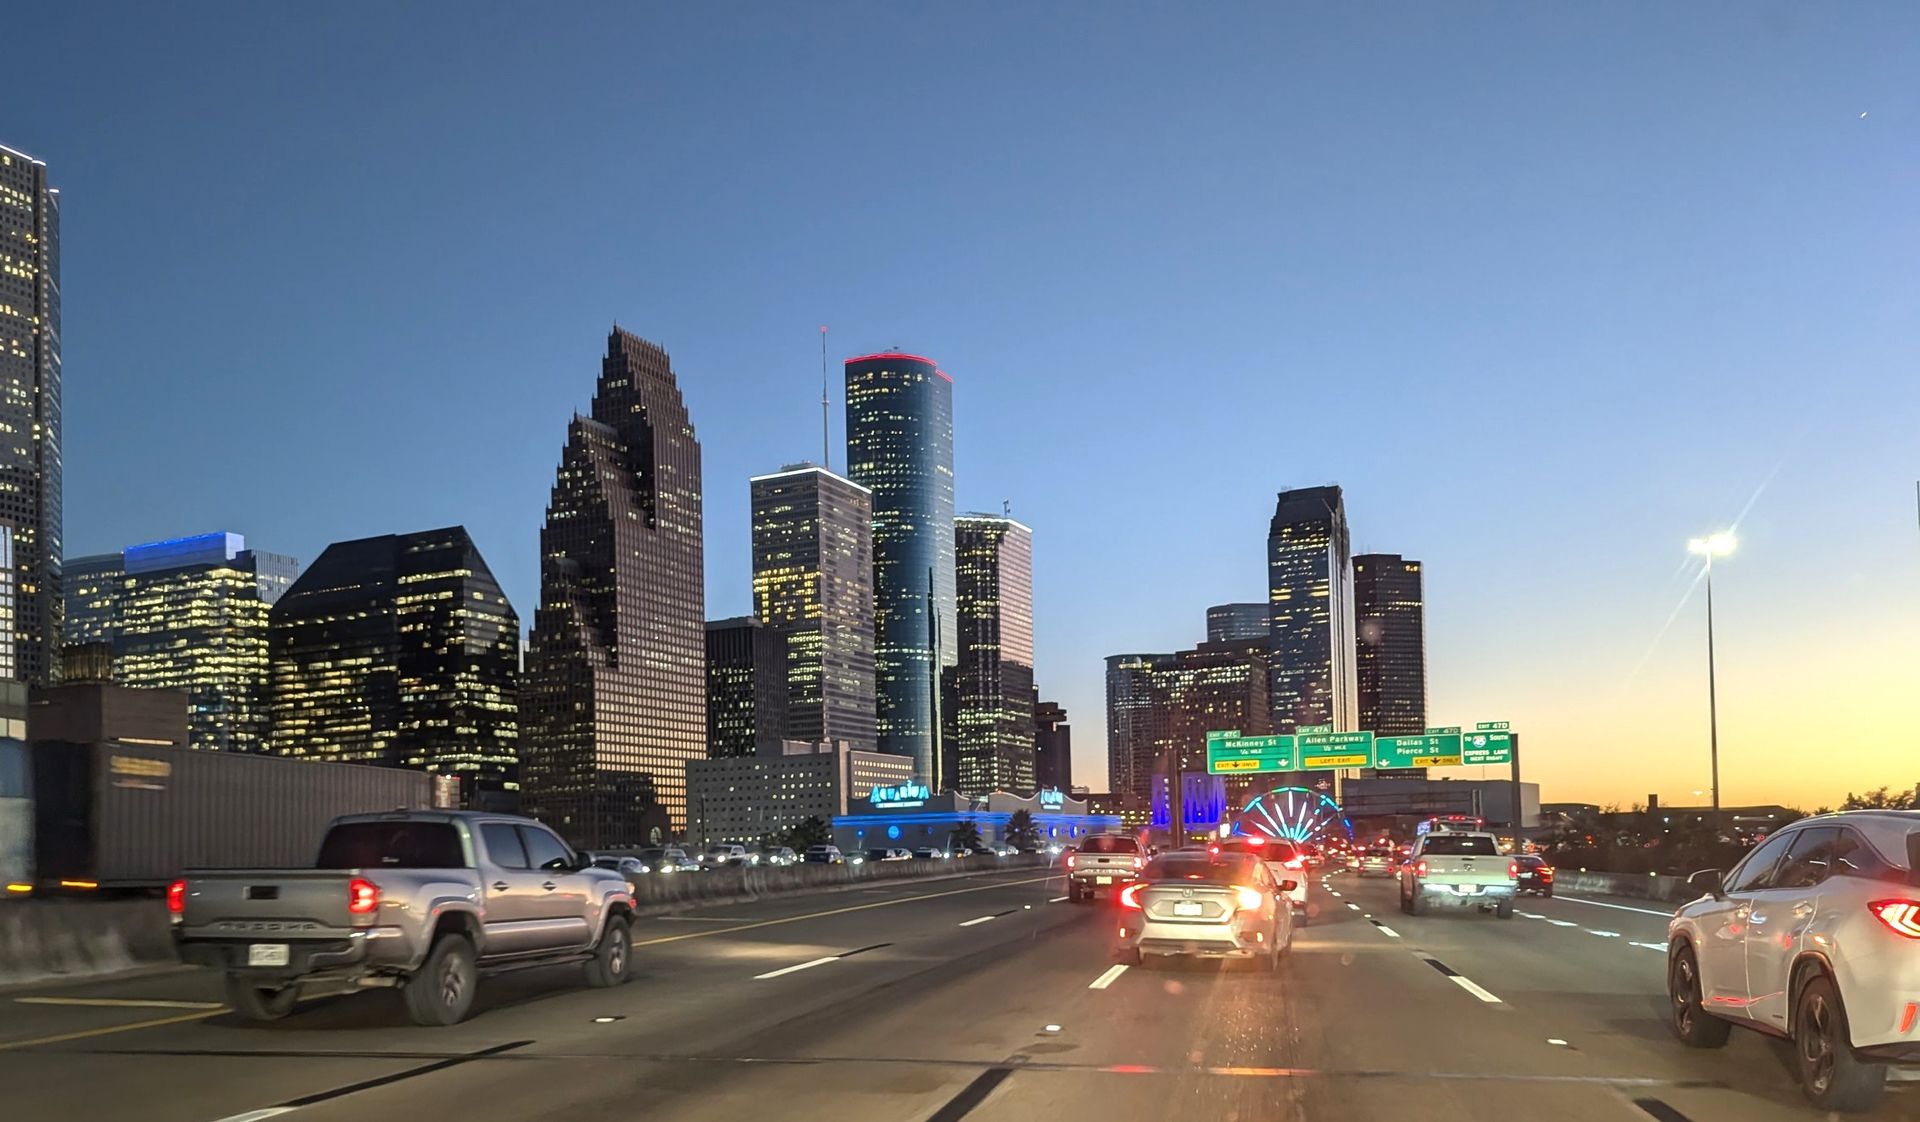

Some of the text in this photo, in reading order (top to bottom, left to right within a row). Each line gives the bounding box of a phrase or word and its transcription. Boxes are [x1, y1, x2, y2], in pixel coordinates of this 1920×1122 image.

[1305, 735, 1364, 744] Allen Parkway
[1396, 739, 1423, 747] Dallas
[1225, 740, 1264, 748] McKinney
